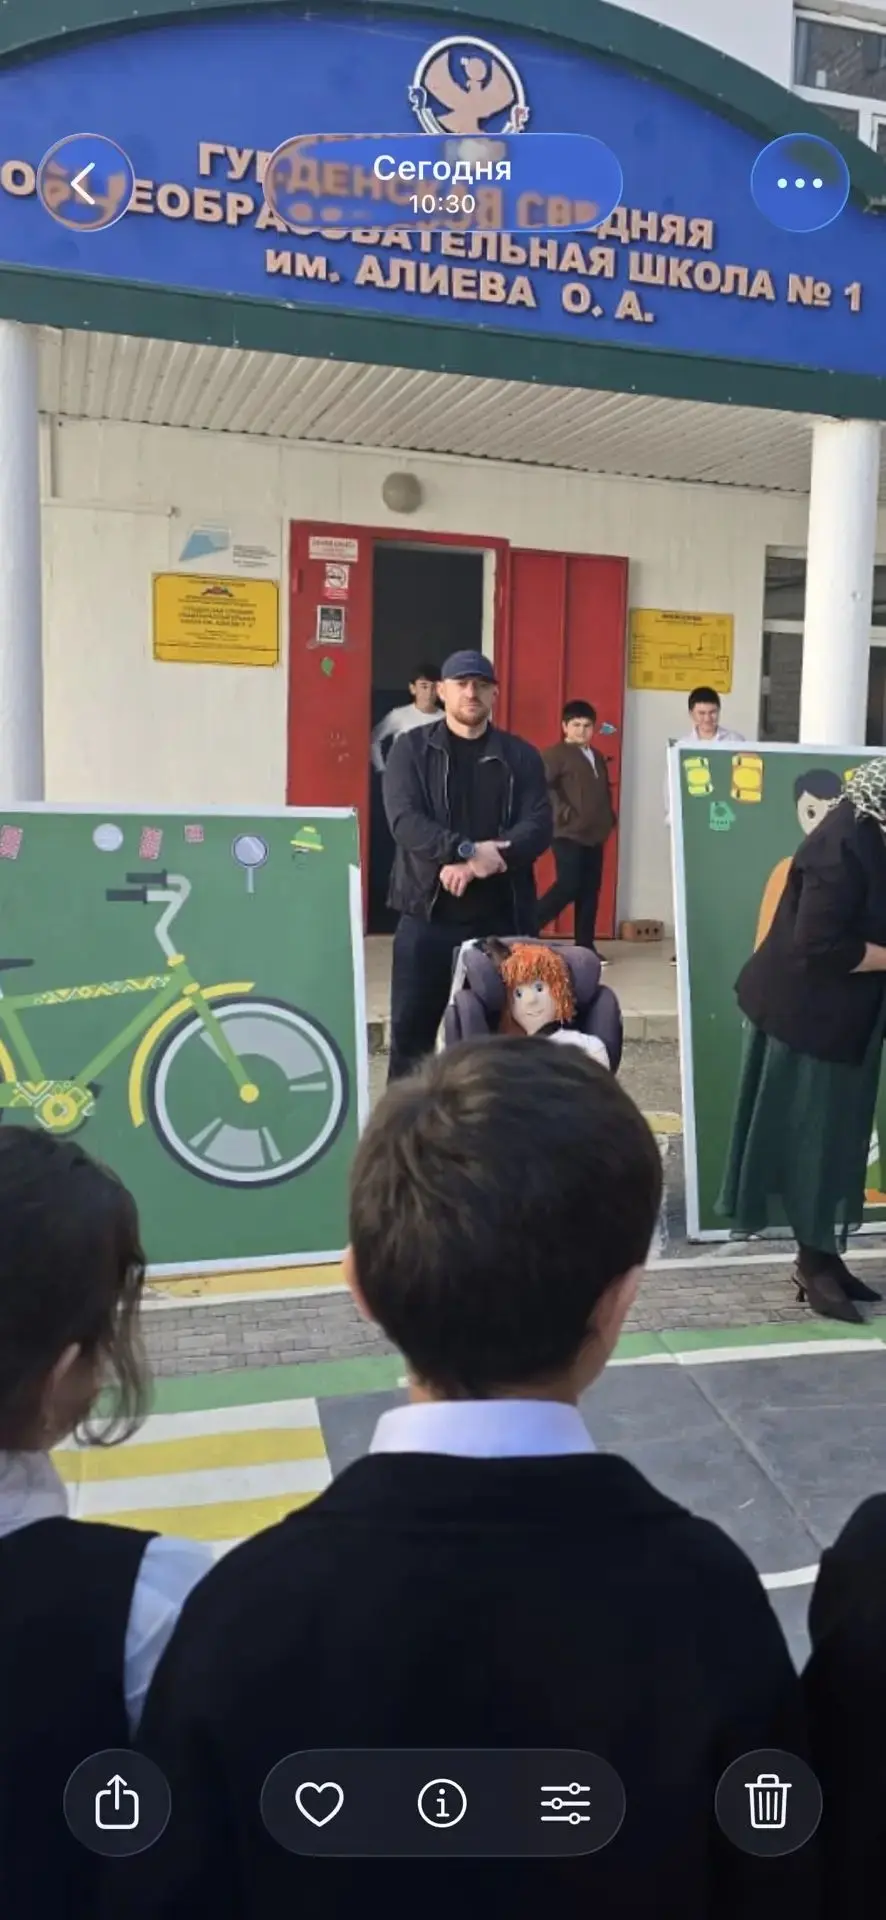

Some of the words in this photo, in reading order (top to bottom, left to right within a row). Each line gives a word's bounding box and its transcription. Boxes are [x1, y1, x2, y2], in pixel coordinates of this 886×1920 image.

[354, 254, 537, 308] АЛИЕВА
[615, 290, 655, 323] А.
[628, 253, 776, 300] ШКОЛА
[787, 273, 831, 306] №
[844, 282, 862, 312] 1
